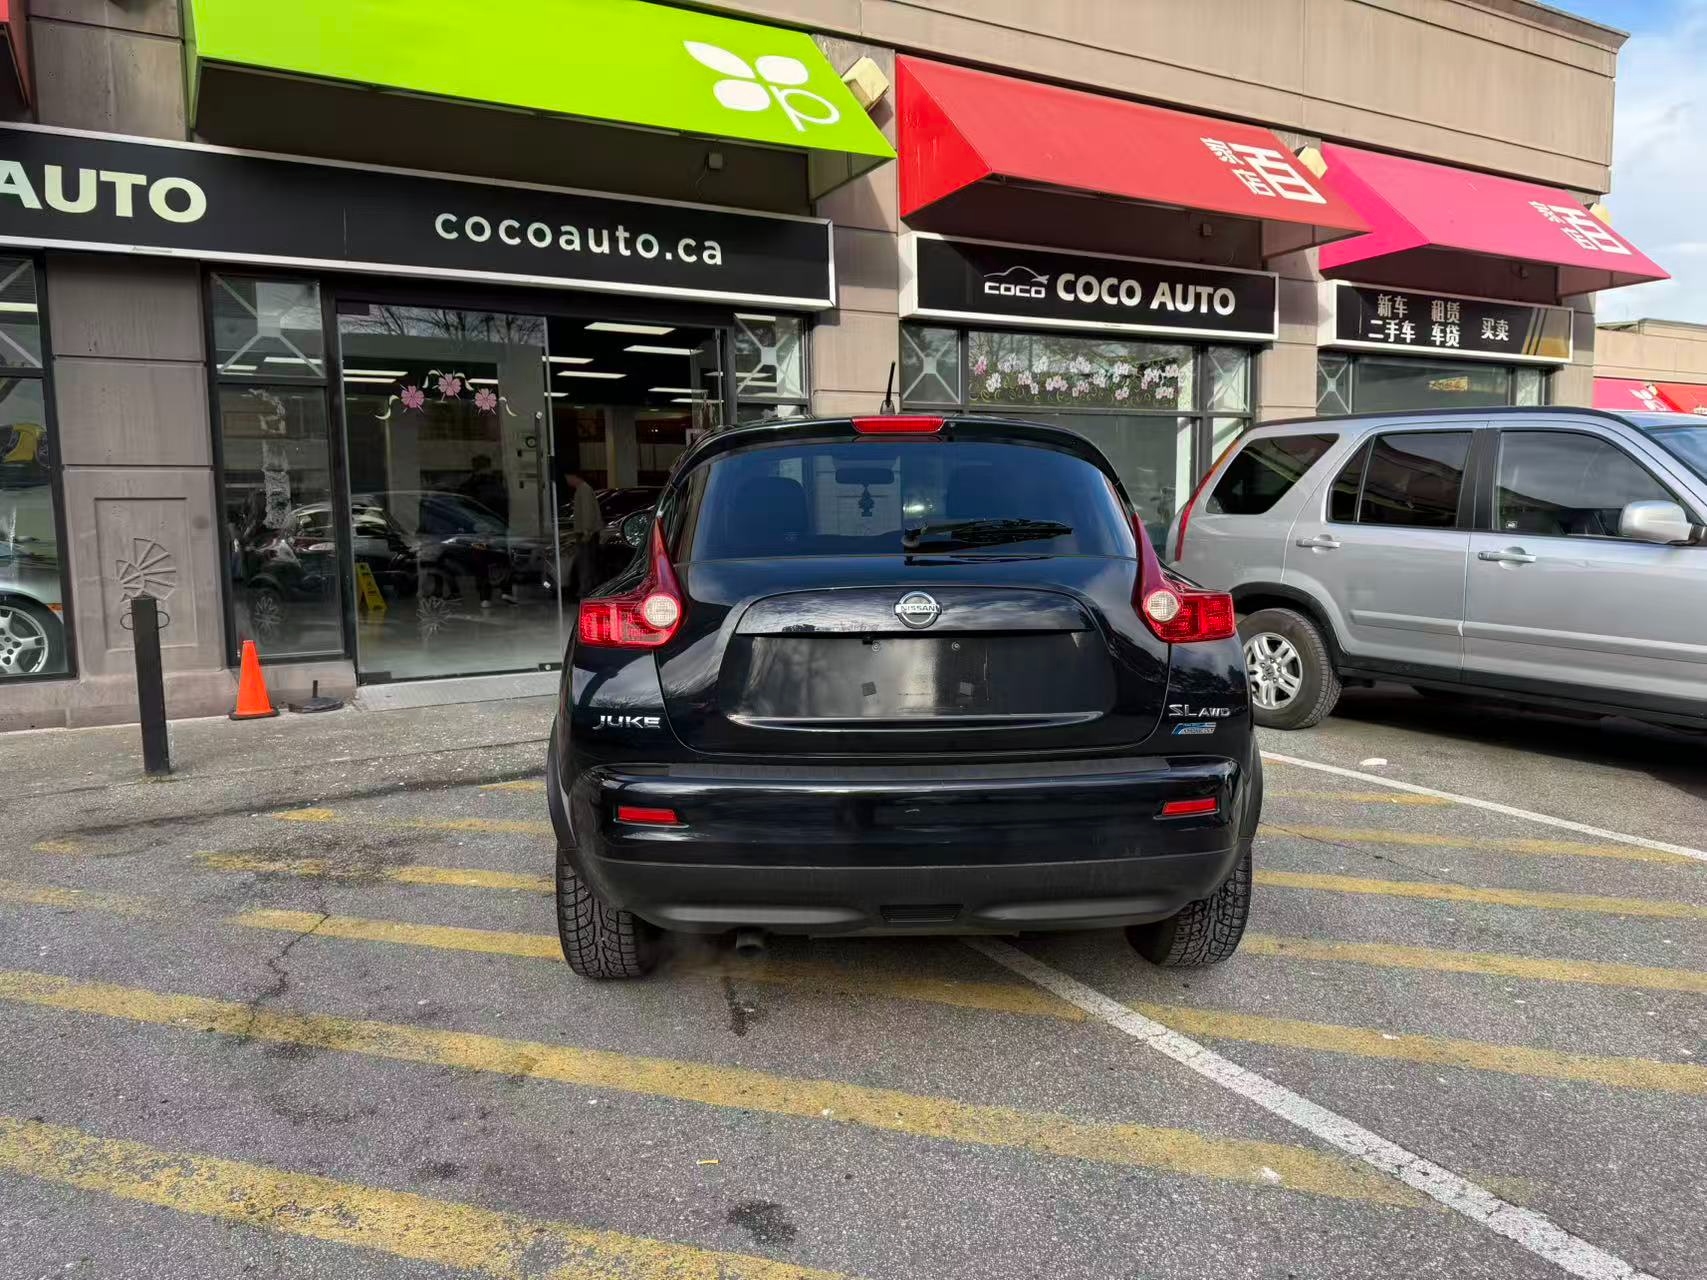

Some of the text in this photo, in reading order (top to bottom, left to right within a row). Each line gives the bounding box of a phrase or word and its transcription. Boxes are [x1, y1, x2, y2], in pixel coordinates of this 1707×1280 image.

[0, 160, 207, 223] AUTO
[434, 212, 722, 265] cocoauto.ca
[984, 282, 1046, 298] COCO
[1056, 273, 1236, 316] COCO AUTO
[1377, 293, 1409, 318] 新车
[1431, 300, 1461, 324] 租赁
[1368, 319, 1416, 343] 二手车
[1431, 323, 1461, 347] 车贷
[1481, 317, 1510, 341] 买卖
[900, 604, 935, 612] NISSAN
[592, 715, 661, 730] JUKE
[1198, 707, 1231, 717] AWD
